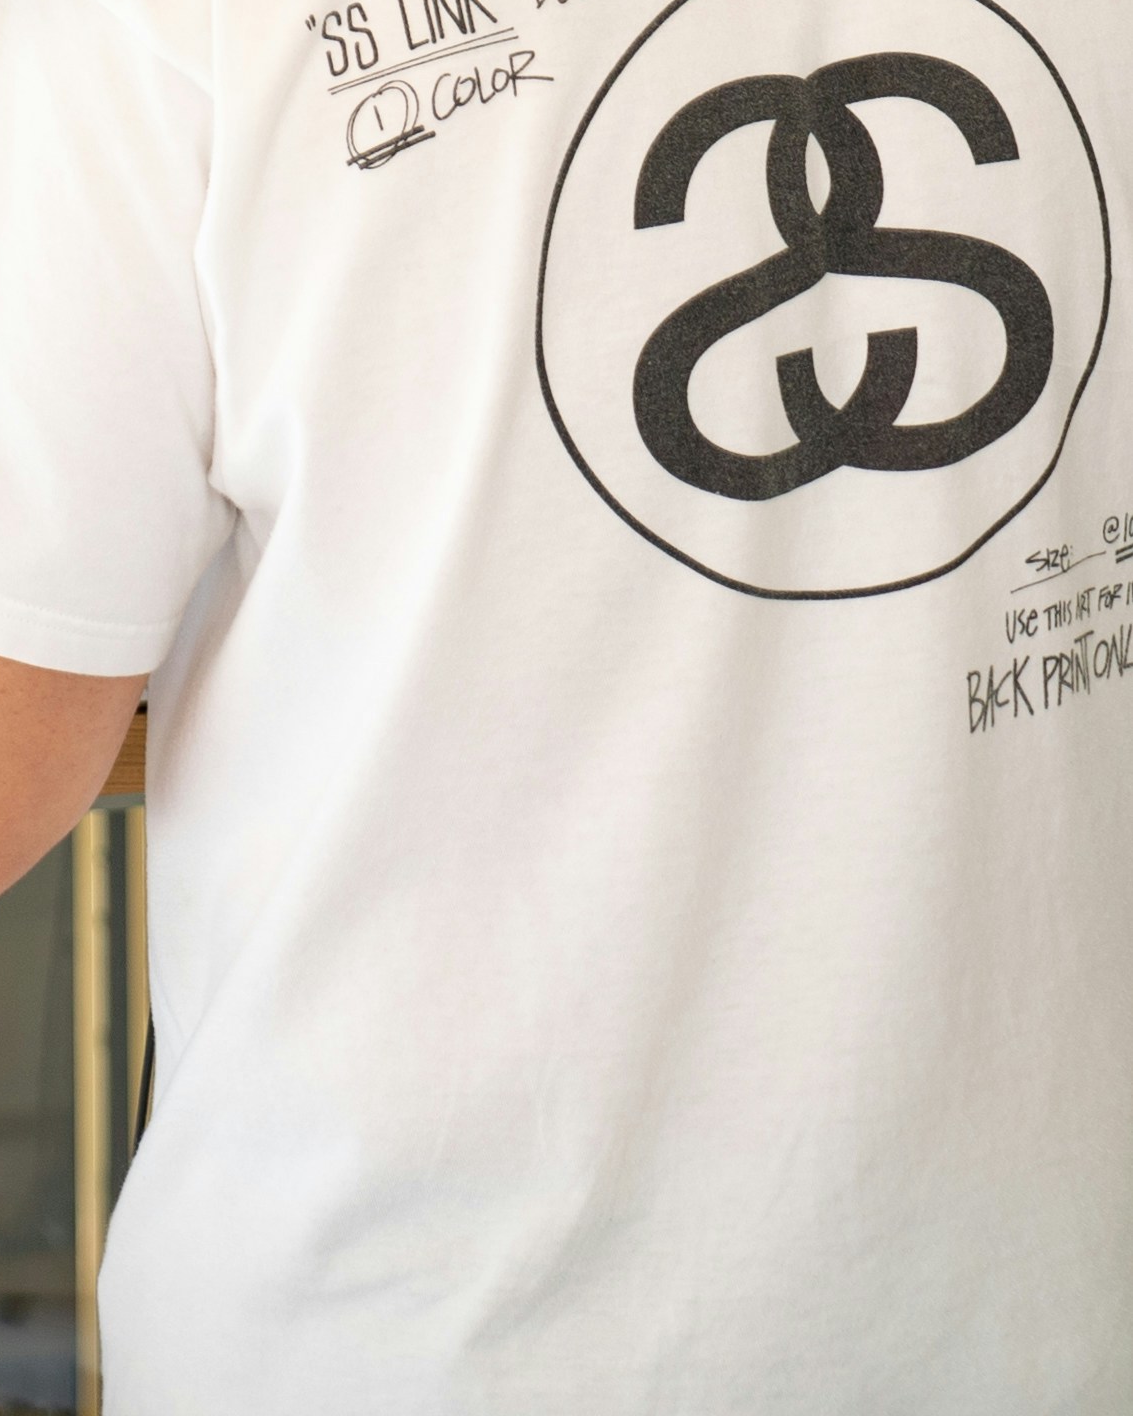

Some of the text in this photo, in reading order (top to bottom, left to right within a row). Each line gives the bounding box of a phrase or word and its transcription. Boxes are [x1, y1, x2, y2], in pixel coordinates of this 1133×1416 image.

[431, 50, 554, 121] COLOR
[1043, 599, 1072, 631] THIS
[1098, 582, 1122, 612] FOR
[966, 655, 1034, 734] BACK
[1042, 630, 1095, 711] PRINT
